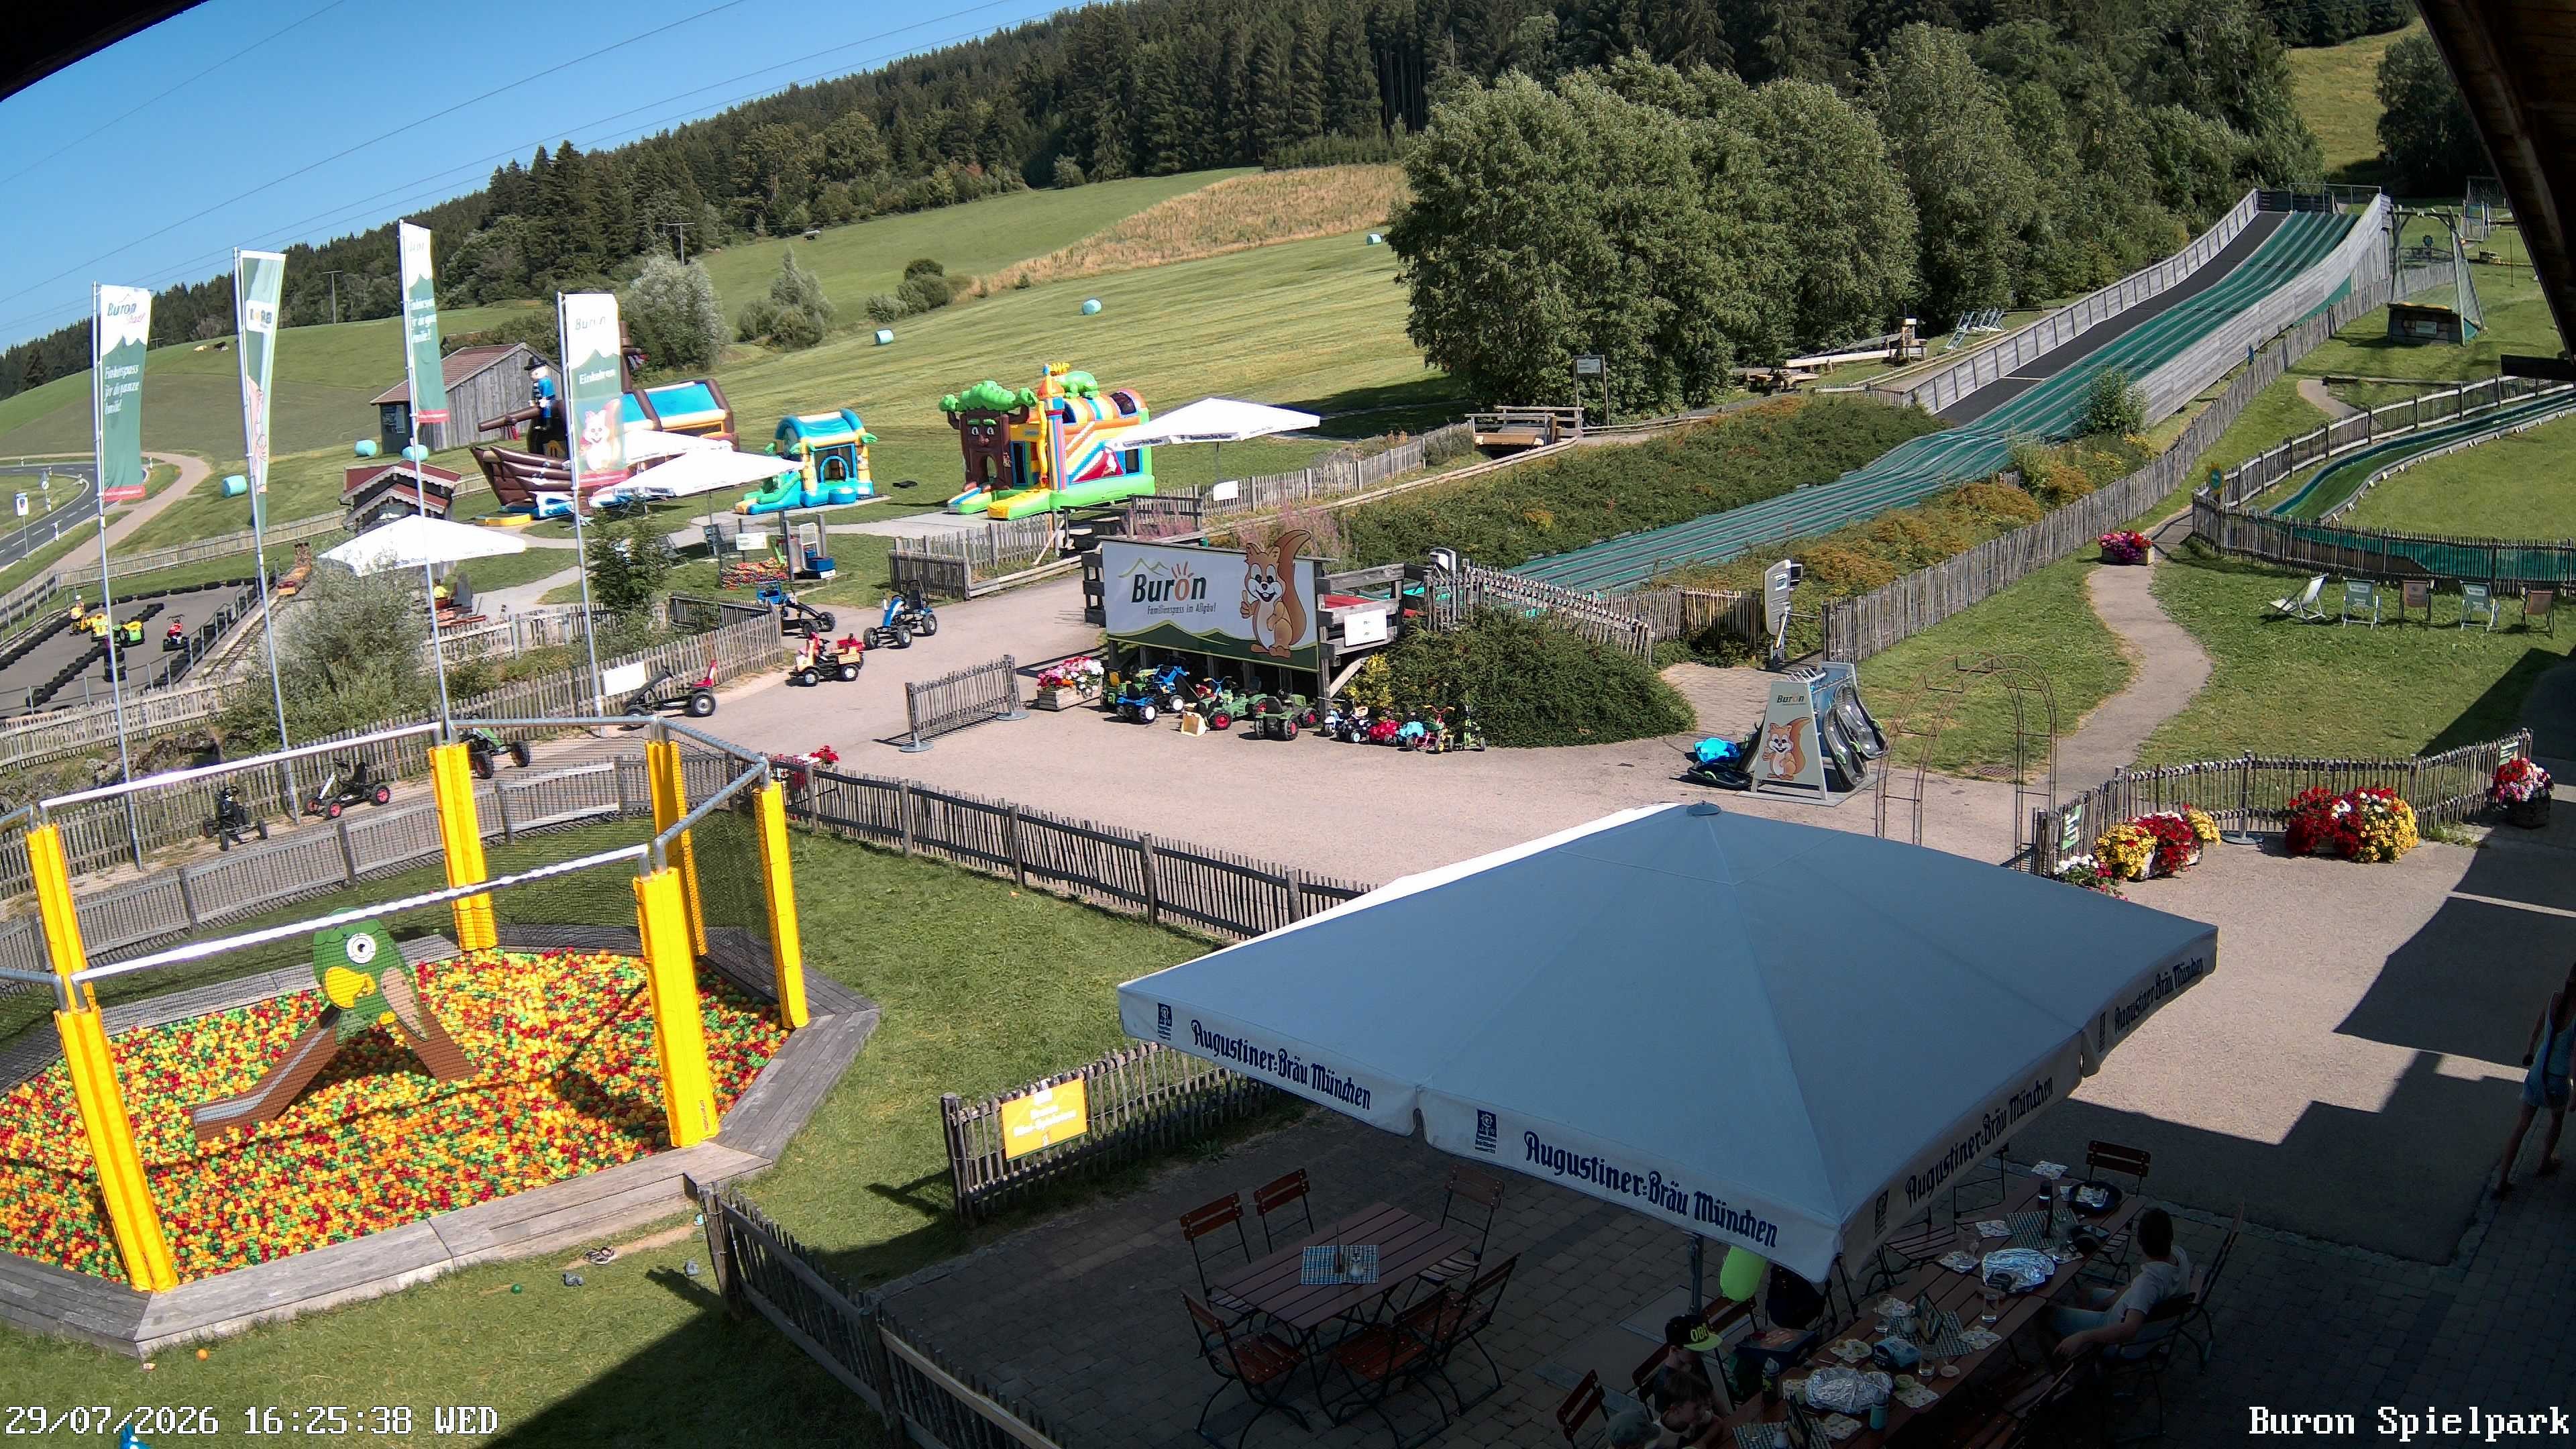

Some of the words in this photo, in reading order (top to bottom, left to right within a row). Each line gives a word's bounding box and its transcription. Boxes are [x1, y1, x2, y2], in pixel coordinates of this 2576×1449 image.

[1132, 574, 1206, 603] Buron
[1777, 695, 1804, 703] Buron
[1311, 1063, 1371, 1110] München
[2008, 1077, 2053, 1124] München
[1693, 1191, 1778, 1248] München
